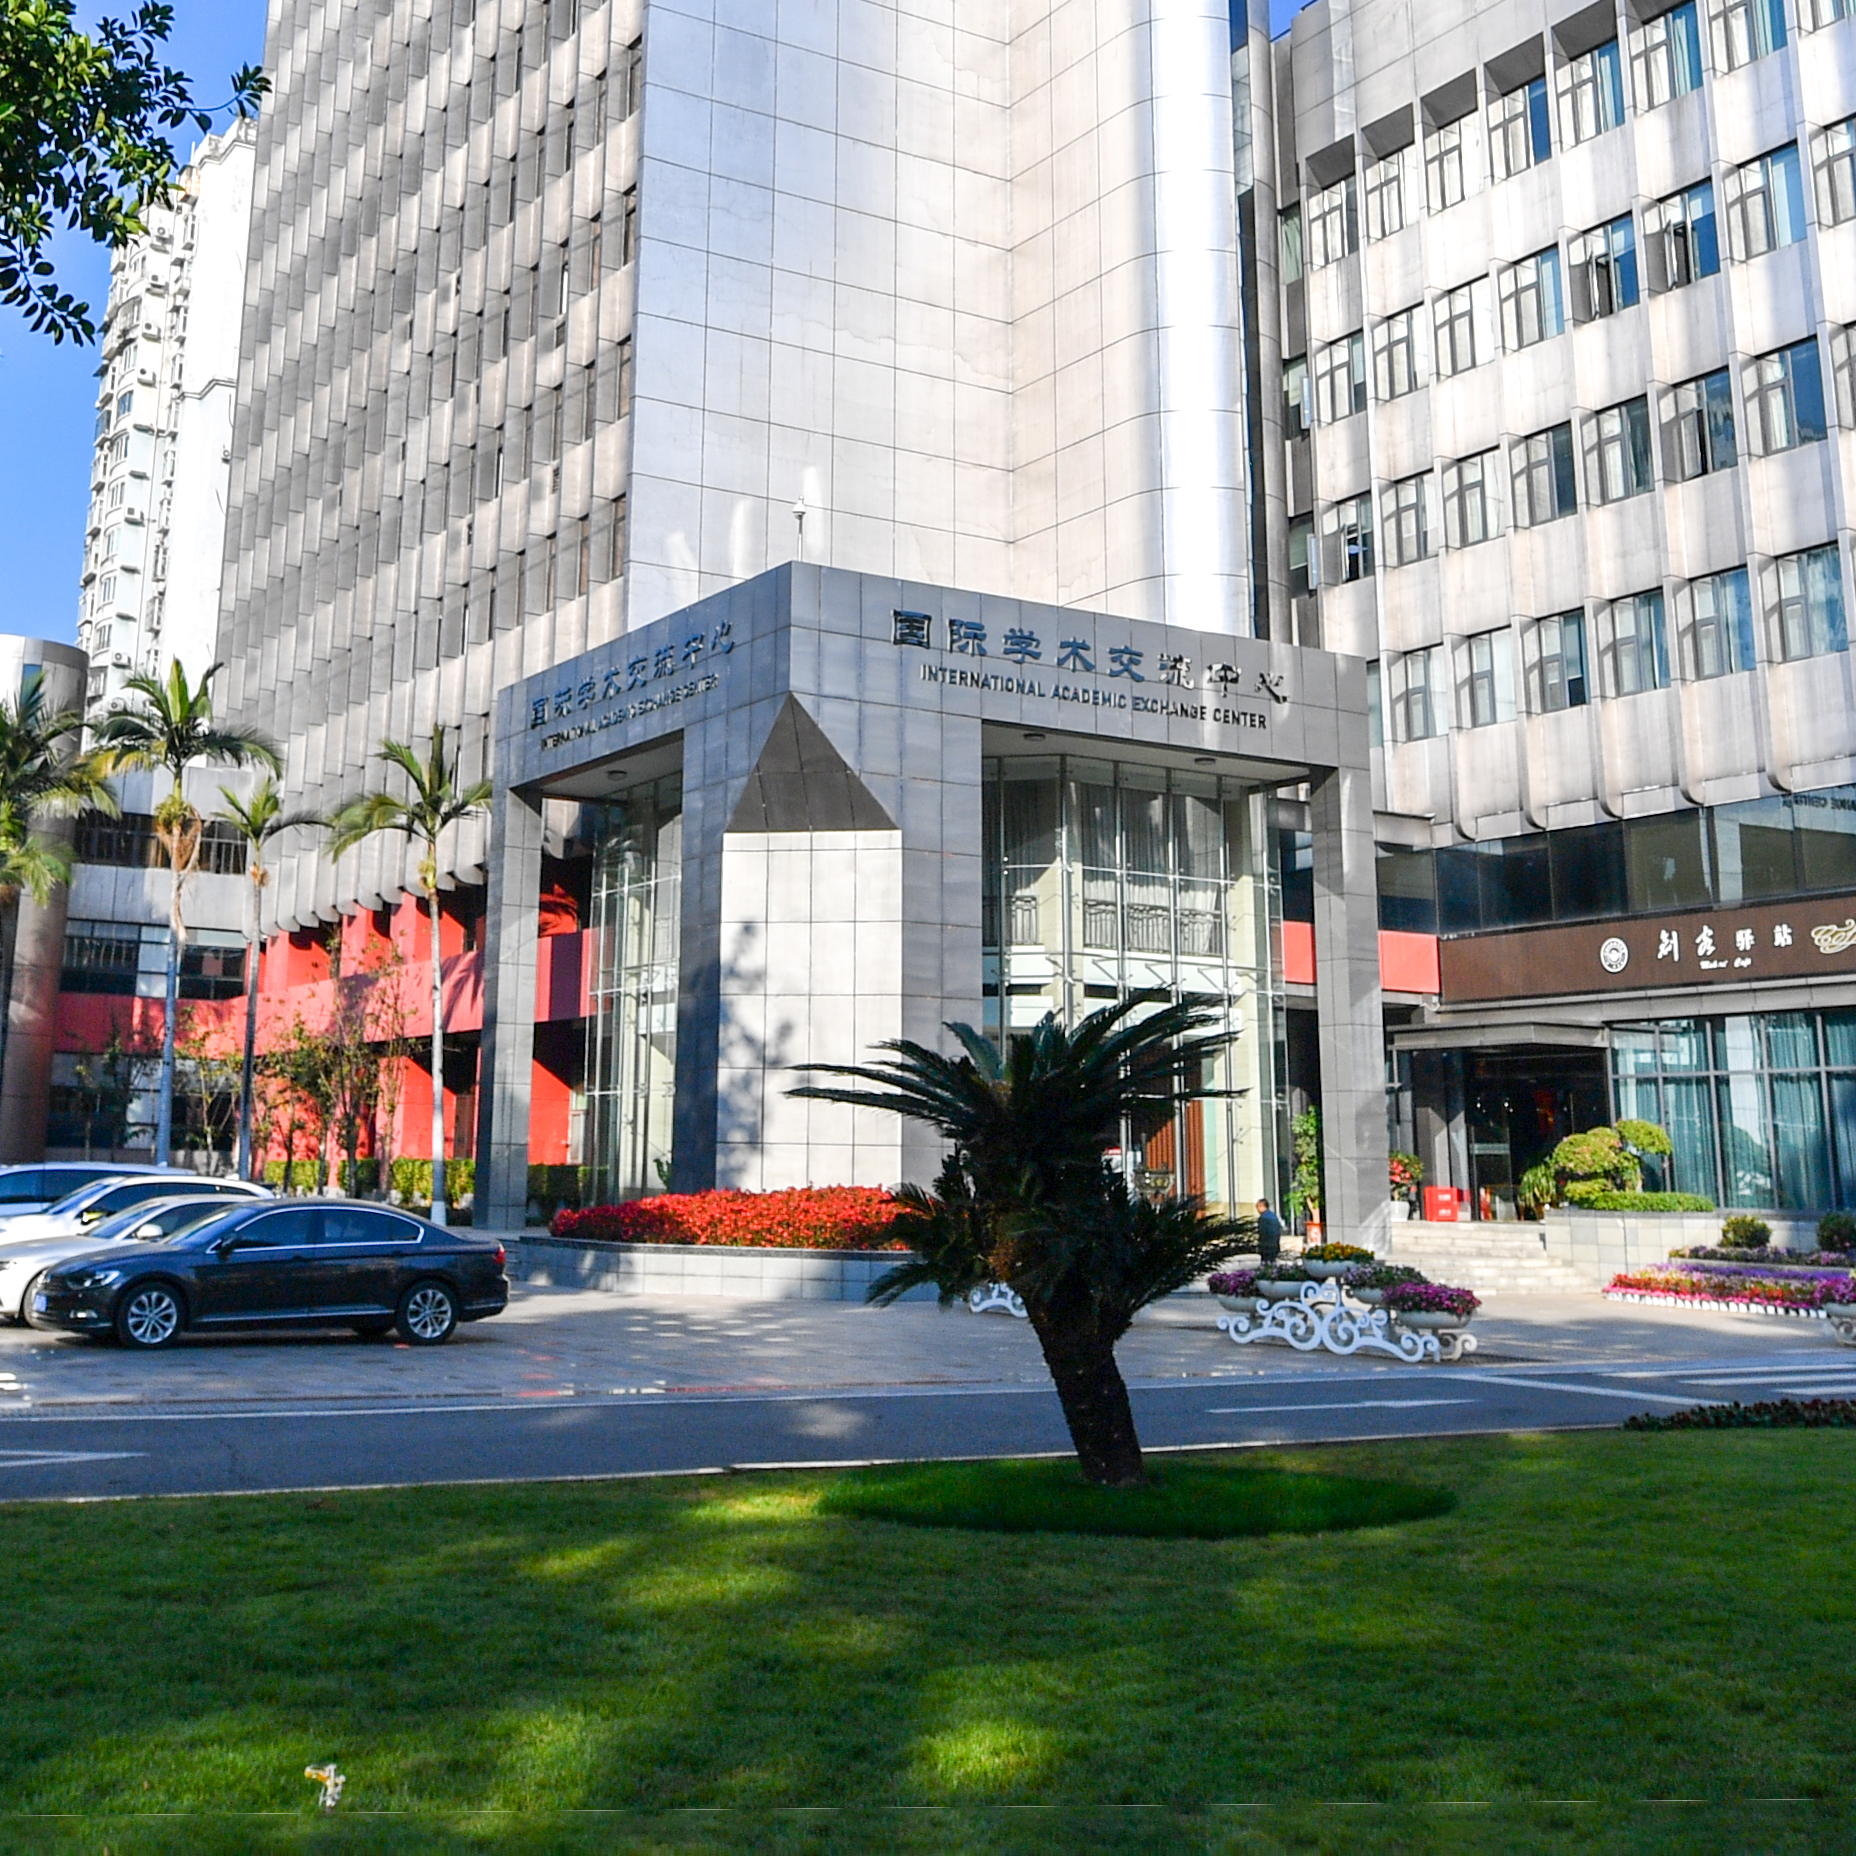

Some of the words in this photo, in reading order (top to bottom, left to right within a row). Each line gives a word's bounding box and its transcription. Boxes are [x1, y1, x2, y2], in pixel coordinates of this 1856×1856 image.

[531, 619, 735, 730] 国际学术交流中心
[890, 609, 1290, 705] 国际学术交流中心
[920, 663, 1046, 698] INTERNATIONAL
[1050, 684, 1127, 710] ACADEMIC
[1132, 696, 1207, 721] EXCHANGE
[1213, 707, 1267, 730] CENTER
